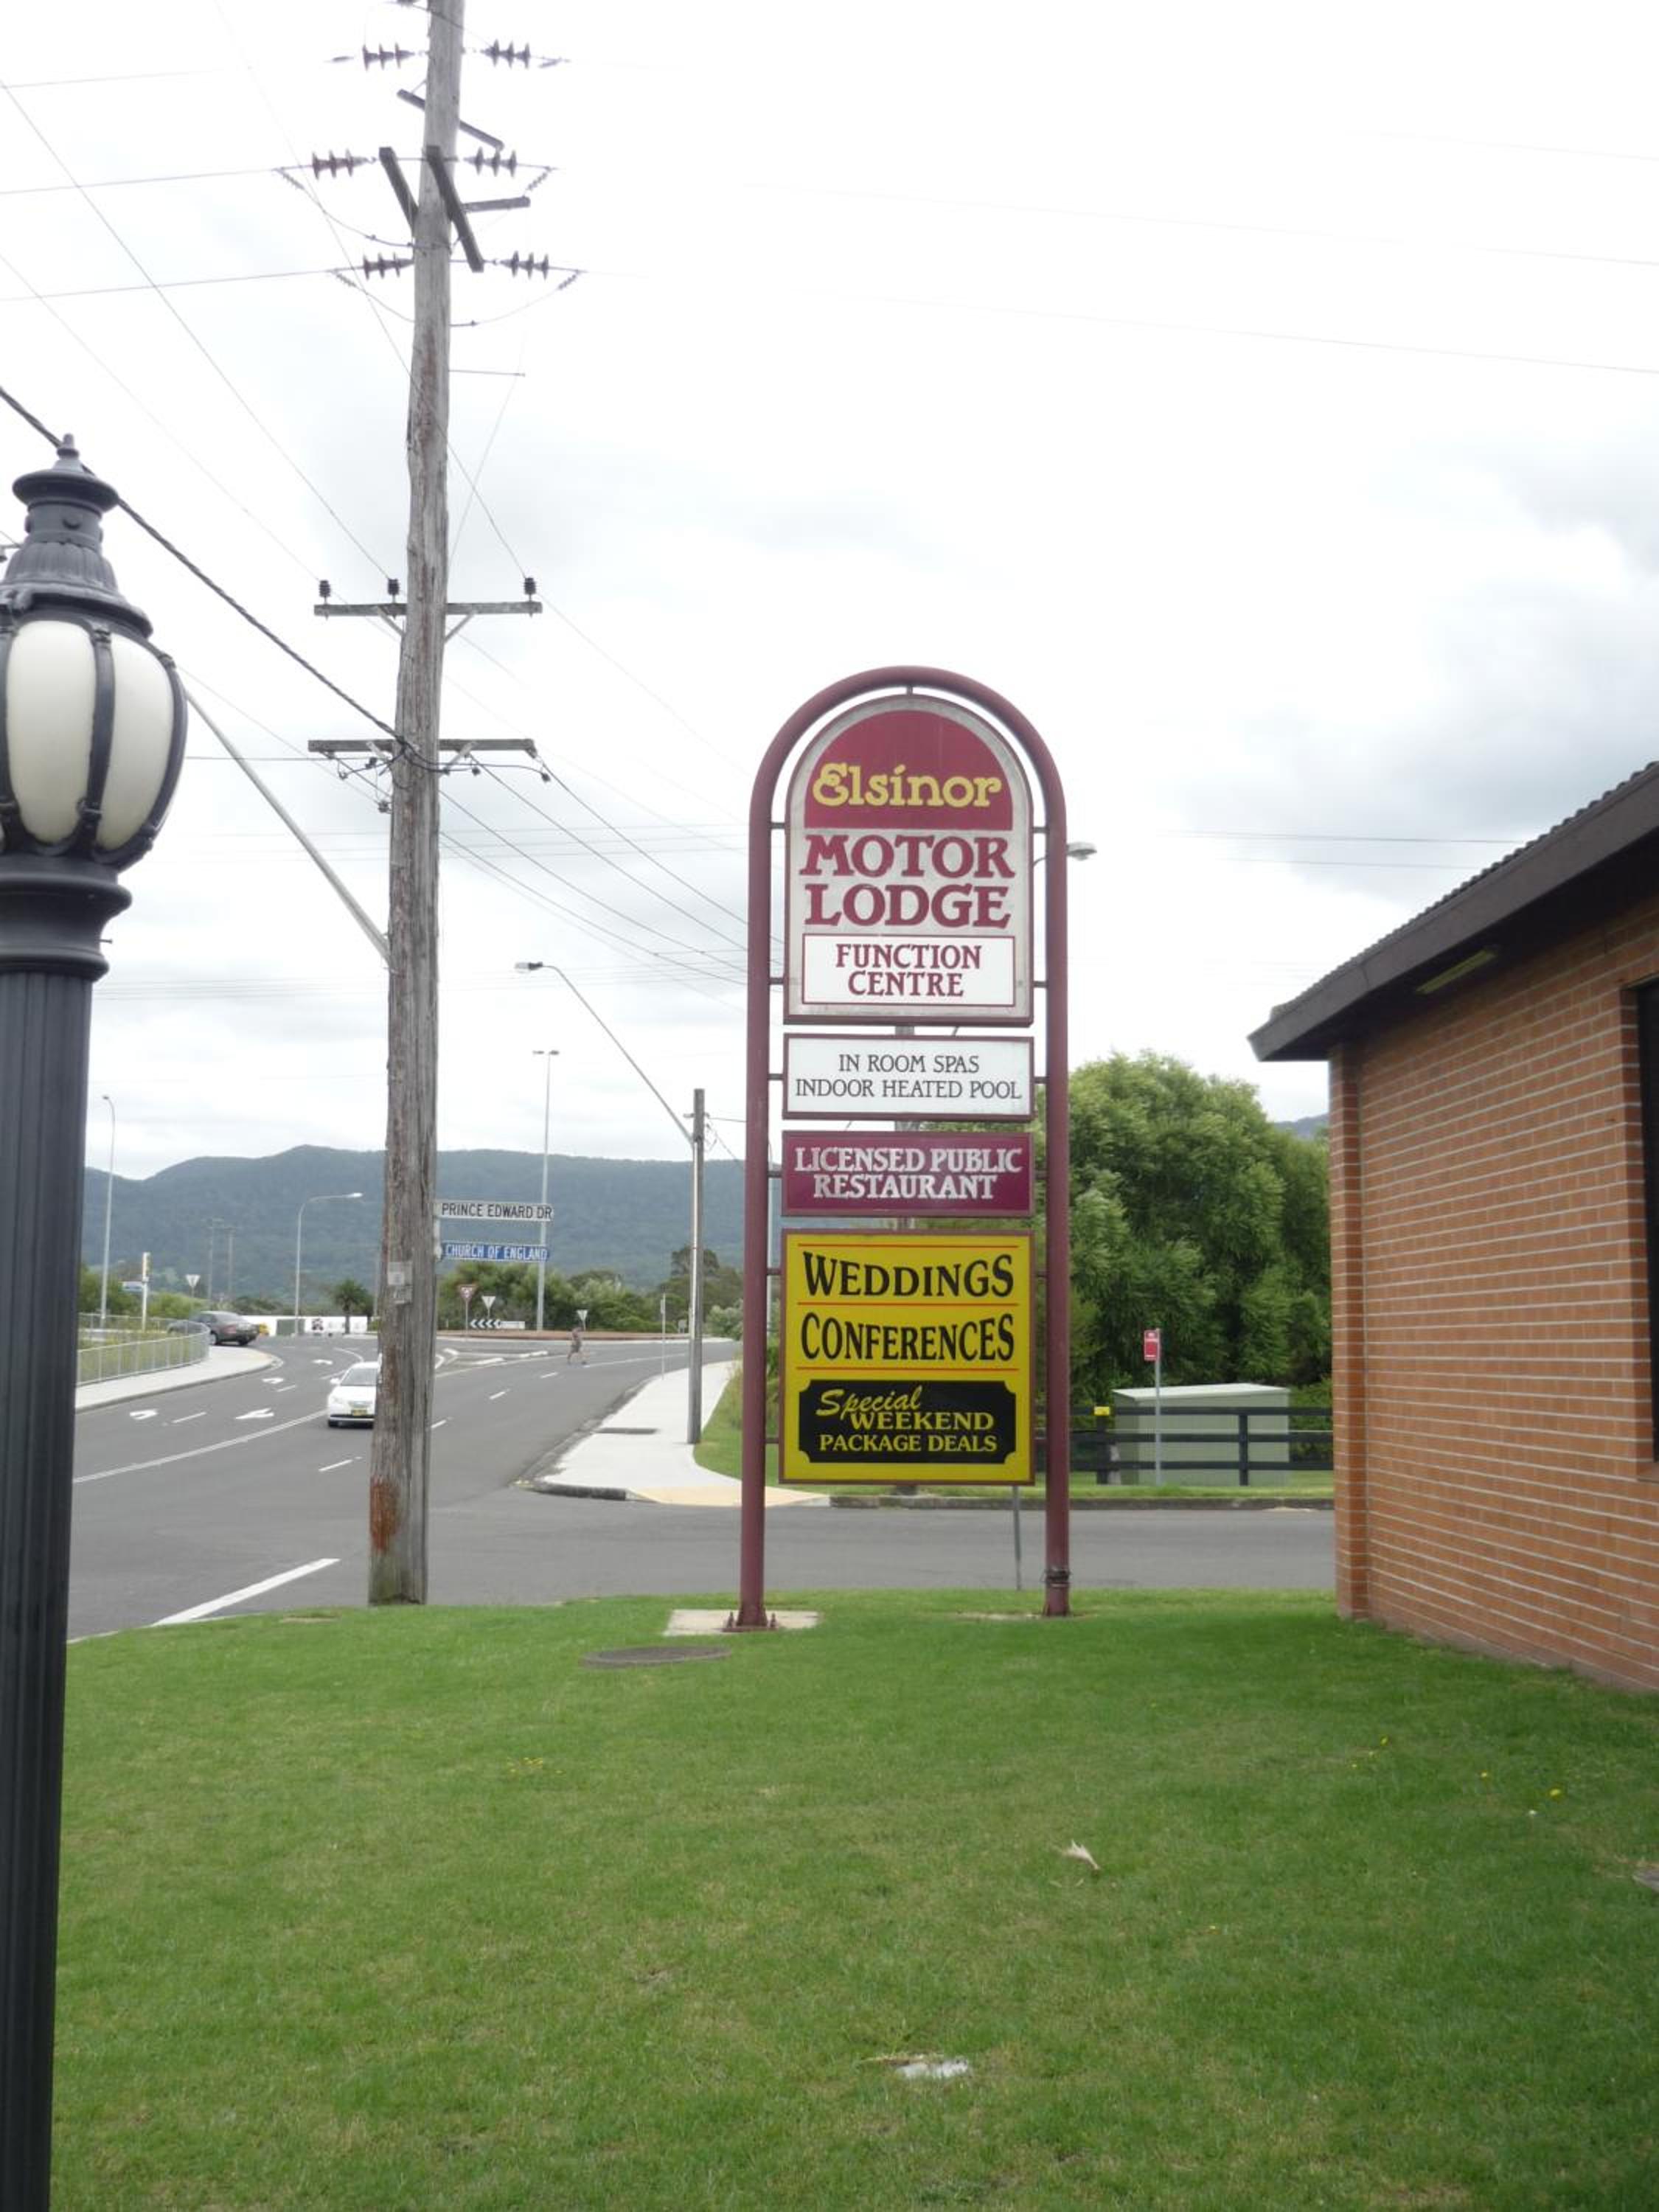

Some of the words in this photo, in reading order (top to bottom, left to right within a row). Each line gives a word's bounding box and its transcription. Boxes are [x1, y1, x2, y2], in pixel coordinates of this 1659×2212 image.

[813, 762, 1002, 807] Elsinor
[799, 835, 1015, 878] MOTOR
[804, 883, 1011, 928] LODGE
[835, 943, 981, 970] FUNCTION
[848, 970, 964, 997] CENTRE
[839, 1054, 860, 1072] IN
[868, 1054, 925, 1073] ROOM
[933, 1055, 980, 1074] SPAS
[796, 1079, 875, 1097] INDOOR
[883, 1079, 962, 1099] HEATED
[970, 1080, 1022, 1099] POOL
[794, 1147, 925, 1172] LICENSED
[930, 1147, 1023, 1173] PUBLIC
[813, 1173, 998, 1200] RESTAURANT
[442, 1203, 484, 1217] PRINCE
[487, 1204, 533, 1219] EDWARD
[536, 1206, 552, 1219] DR
[446, 1244, 484, 1257] CHURCH
[488, 1245, 501, 1259] OF
[504, 1246, 548, 1261] ENGLAND
[803, 1251, 1015, 1298] WEDDINGS
[801, 1312, 1015, 1361] CONFERENCES
[815, 1386, 922, 1420] Special
[849, 1411, 995, 1430] WEEKEND
[818, 1434, 921, 1453] PACKAGE
[928, 1435, 998, 1453] DEALS
